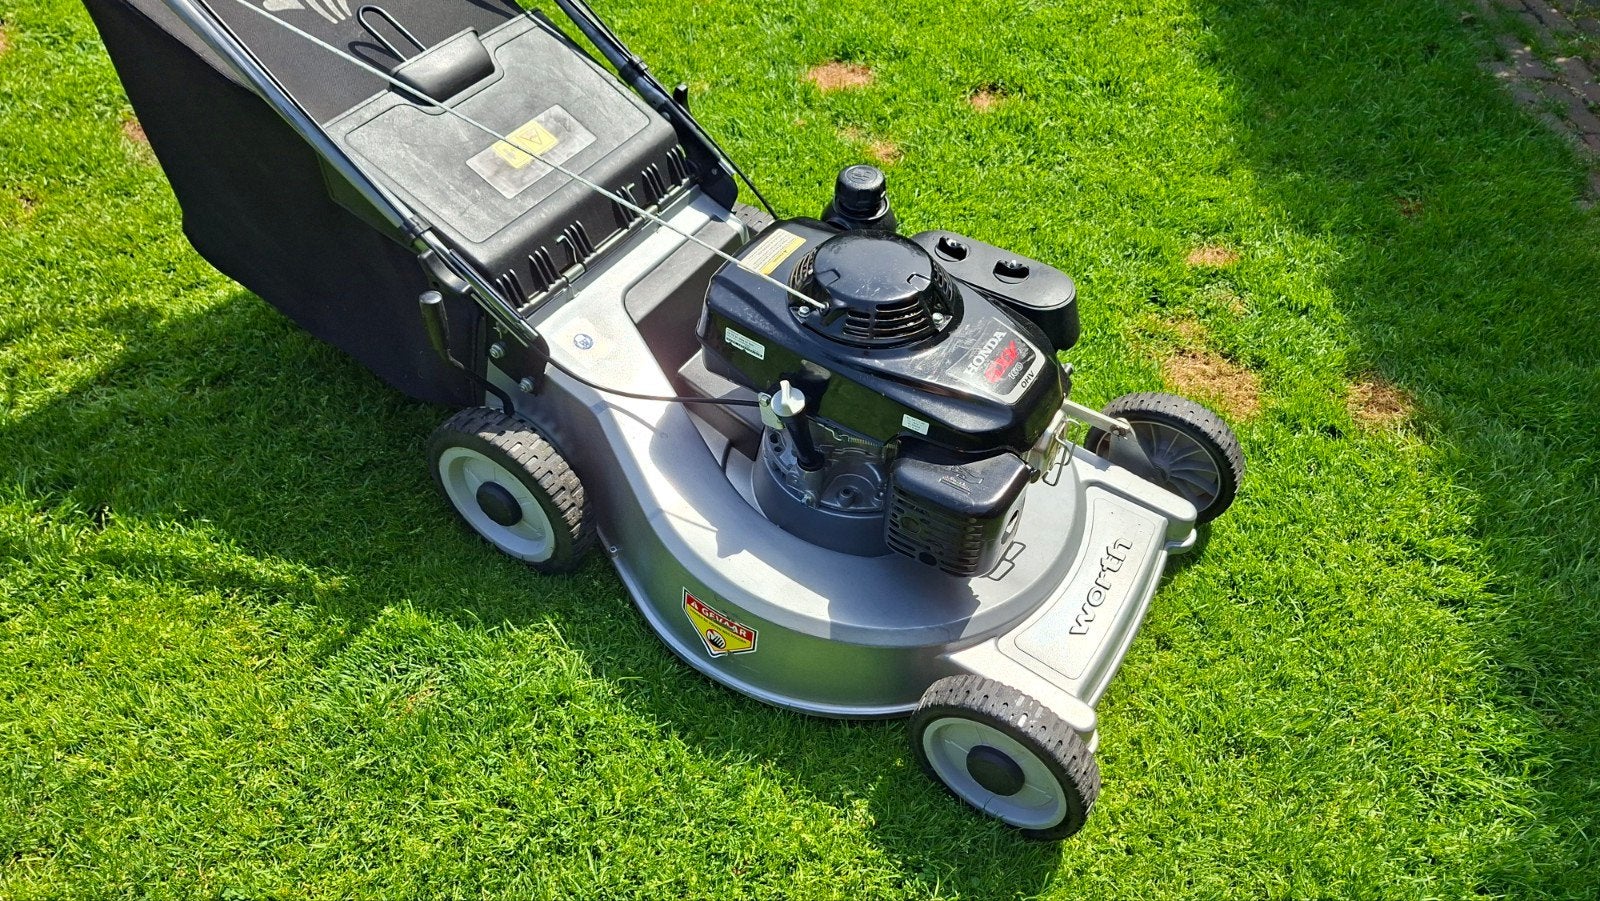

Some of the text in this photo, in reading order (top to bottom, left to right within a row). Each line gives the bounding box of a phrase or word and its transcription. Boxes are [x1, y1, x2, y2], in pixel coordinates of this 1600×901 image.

[963, 331, 1007, 375] HONDA
[1021, 372, 1035, 389] OHV
[1069, 537, 1133, 635] worth
[701, 608, 747, 638] GEVAAR
